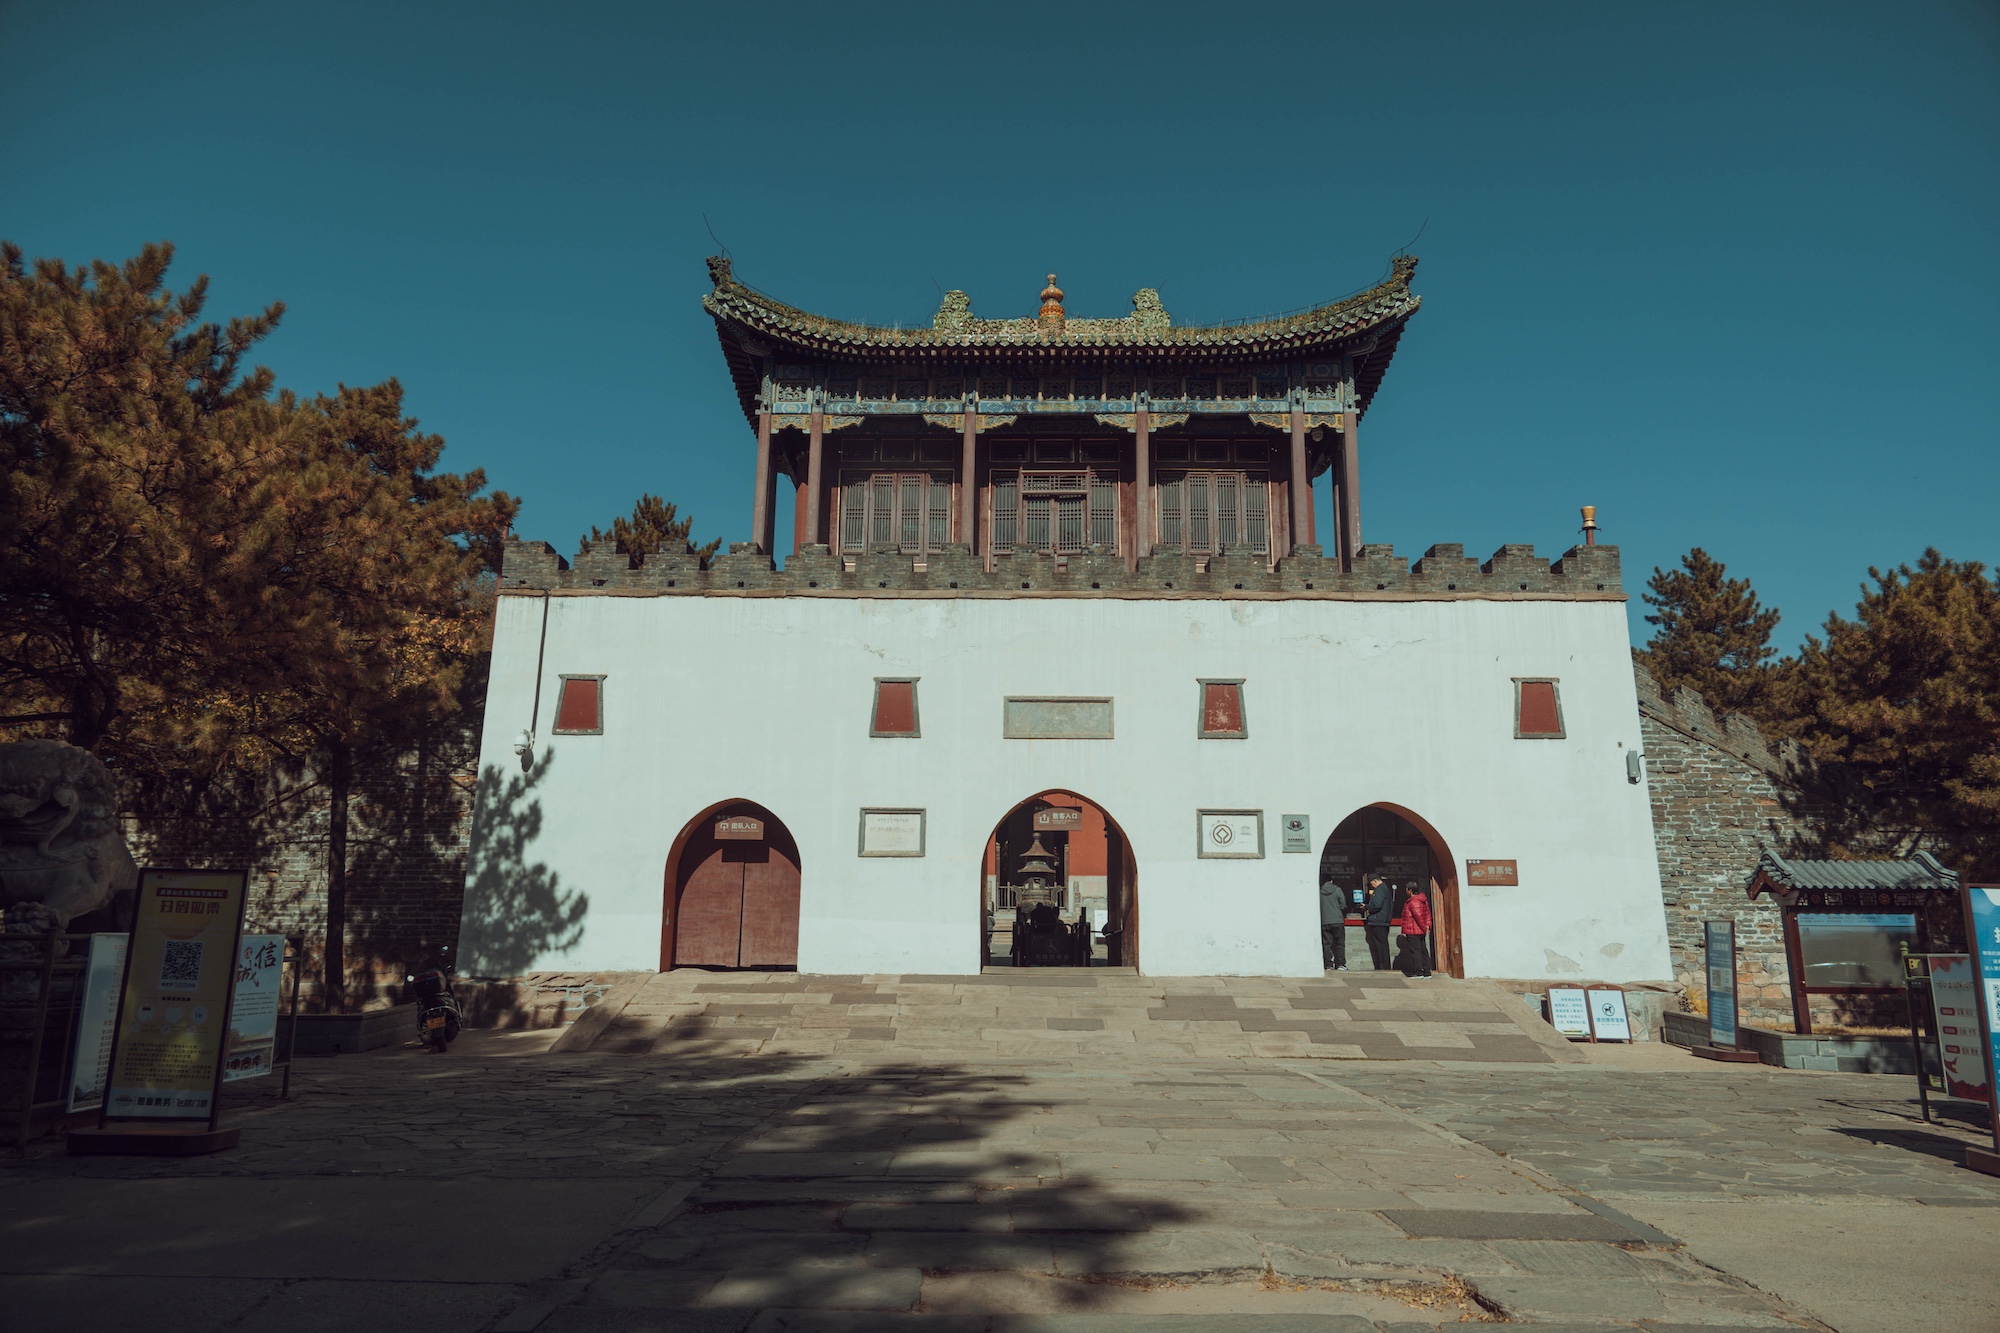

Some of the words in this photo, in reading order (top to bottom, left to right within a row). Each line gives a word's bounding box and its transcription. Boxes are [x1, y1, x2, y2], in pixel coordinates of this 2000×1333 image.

[1487, 866, 1513, 875] 售票处
[160, 900, 221, 915] 扫码购票
